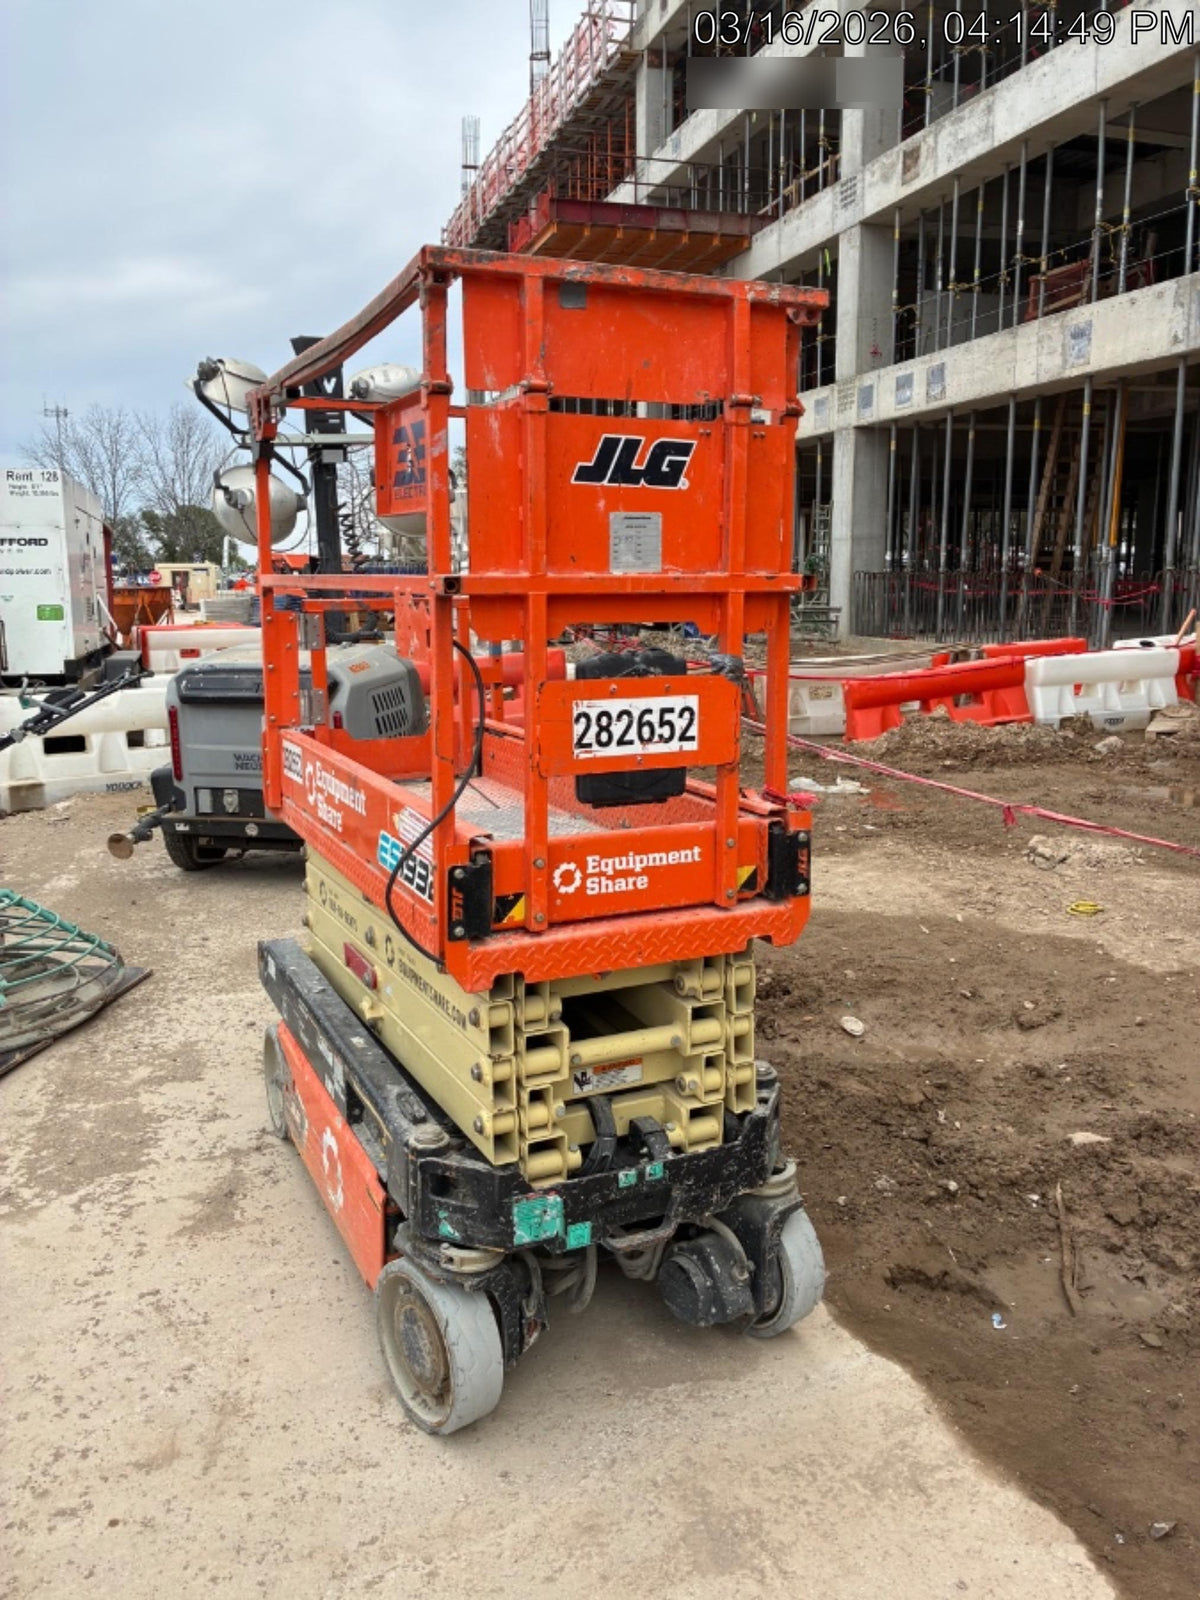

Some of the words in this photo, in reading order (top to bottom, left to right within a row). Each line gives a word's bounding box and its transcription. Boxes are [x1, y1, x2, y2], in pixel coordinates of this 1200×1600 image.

[6, 470, 33, 481] Rent
[571, 434, 697, 489] JLG
[574, 706, 696, 749] 282652
[315, 761, 367, 816] Equipment
[586, 846, 701, 875] Equipment
[586, 875, 649, 895] Share
